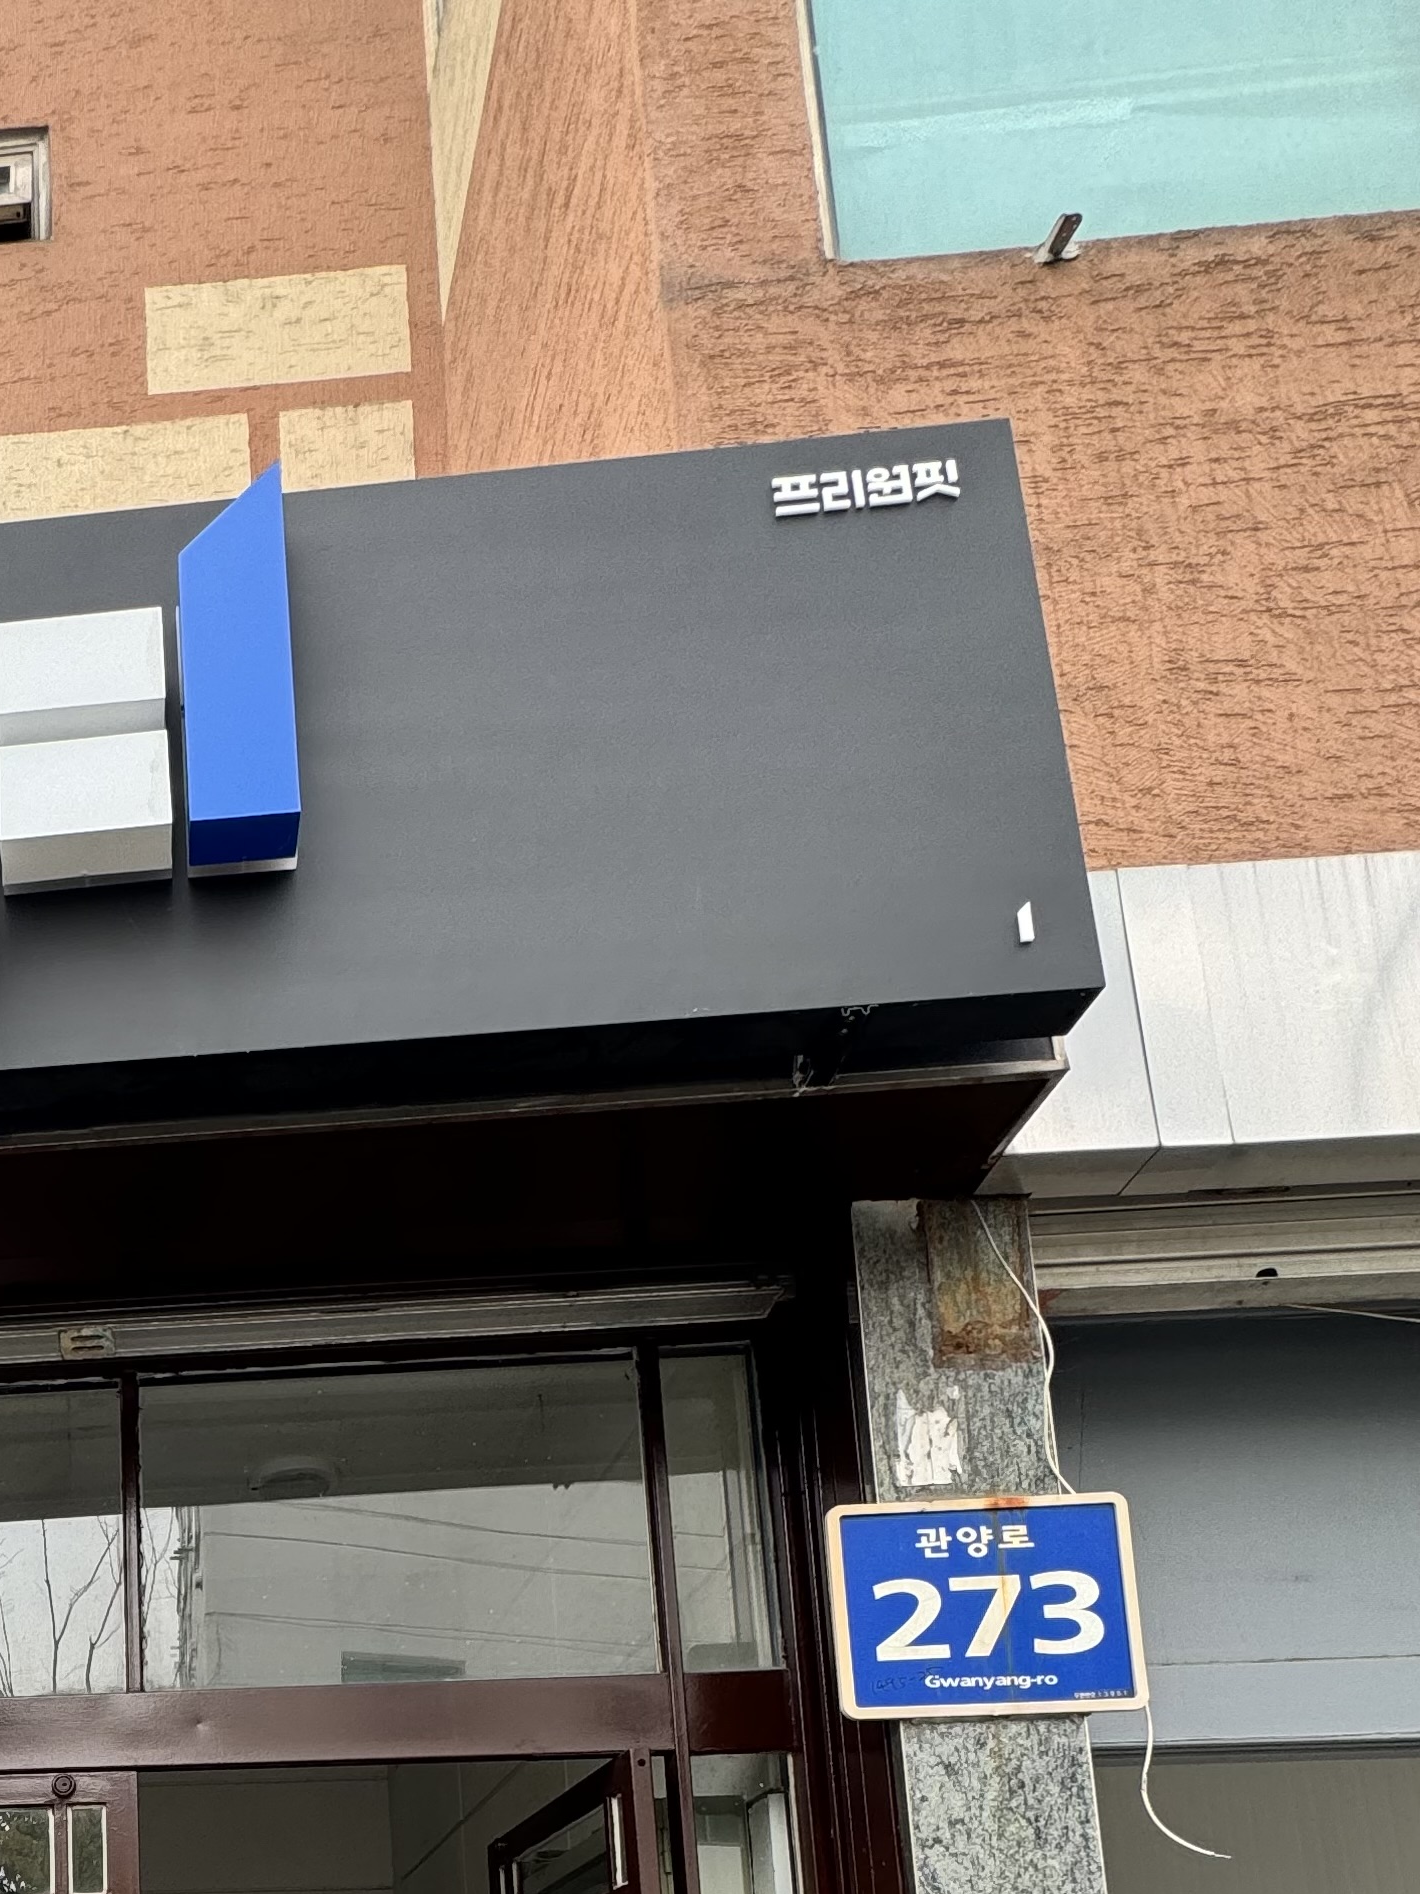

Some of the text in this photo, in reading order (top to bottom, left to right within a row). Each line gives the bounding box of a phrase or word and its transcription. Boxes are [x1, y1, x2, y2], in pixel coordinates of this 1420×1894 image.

[771, 458, 961, 517] 프리원핏
[915, 1525, 1035, 1559] 관양로
[872, 1570, 1105, 1662] 273
[925, 1673, 1058, 1691] Gwanyang-ro
